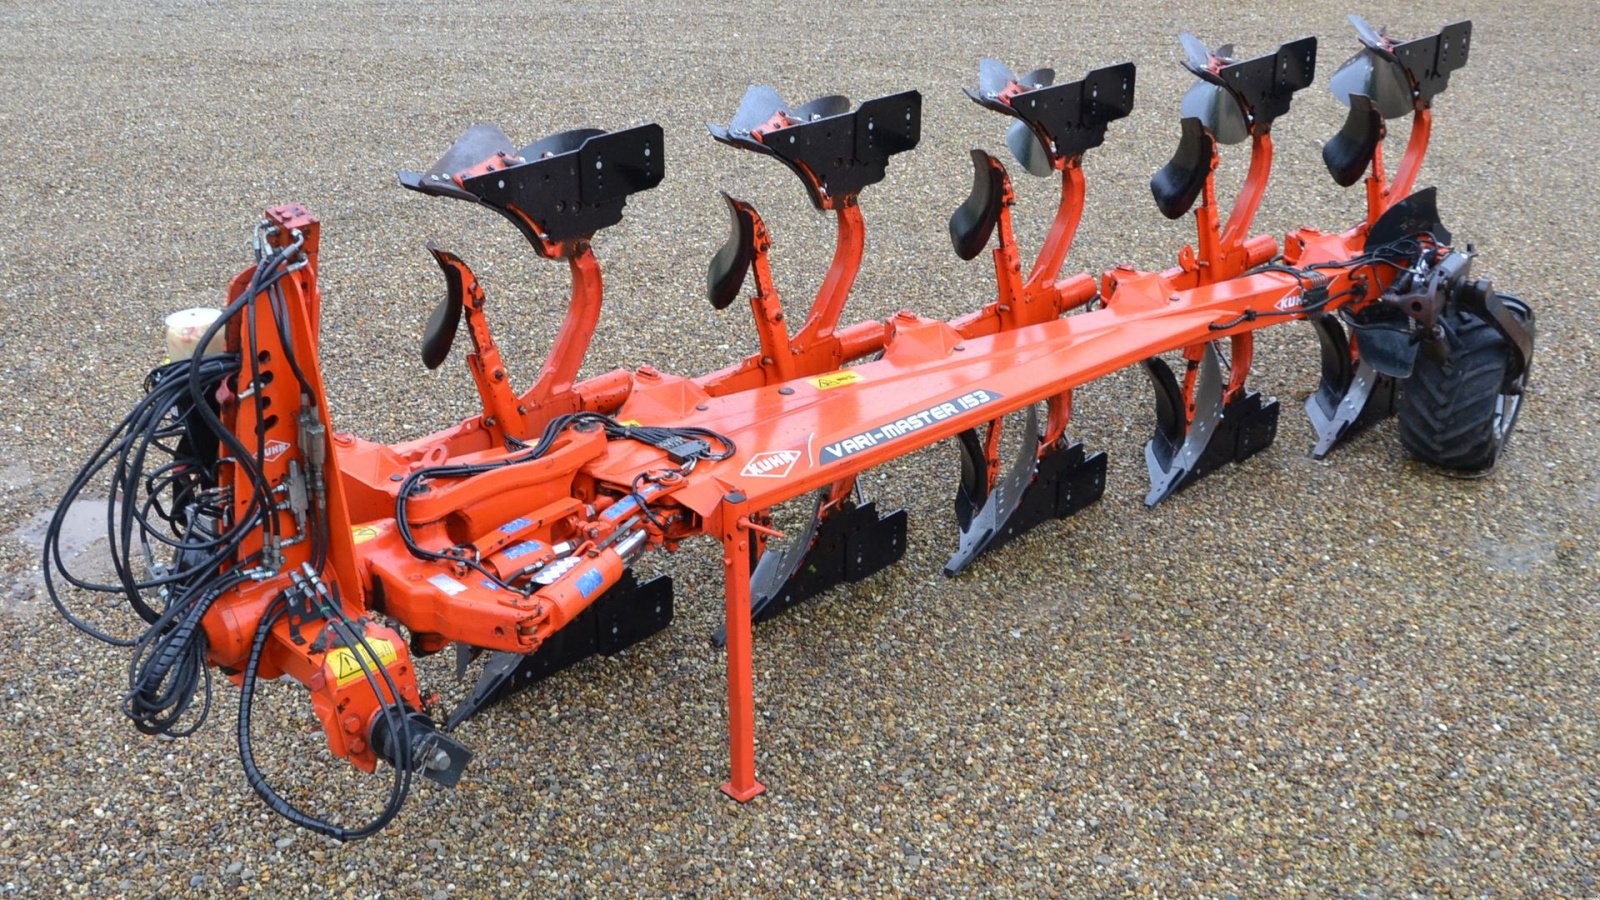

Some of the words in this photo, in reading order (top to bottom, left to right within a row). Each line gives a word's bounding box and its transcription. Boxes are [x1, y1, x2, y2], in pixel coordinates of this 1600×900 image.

[1280, 296, 1302, 310] KUH
[825, 403, 959, 457] VARI-MASTER
[957, 390, 991, 410] 153
[263, 443, 287, 457] UHN
[747, 451, 797, 475] KUHN
